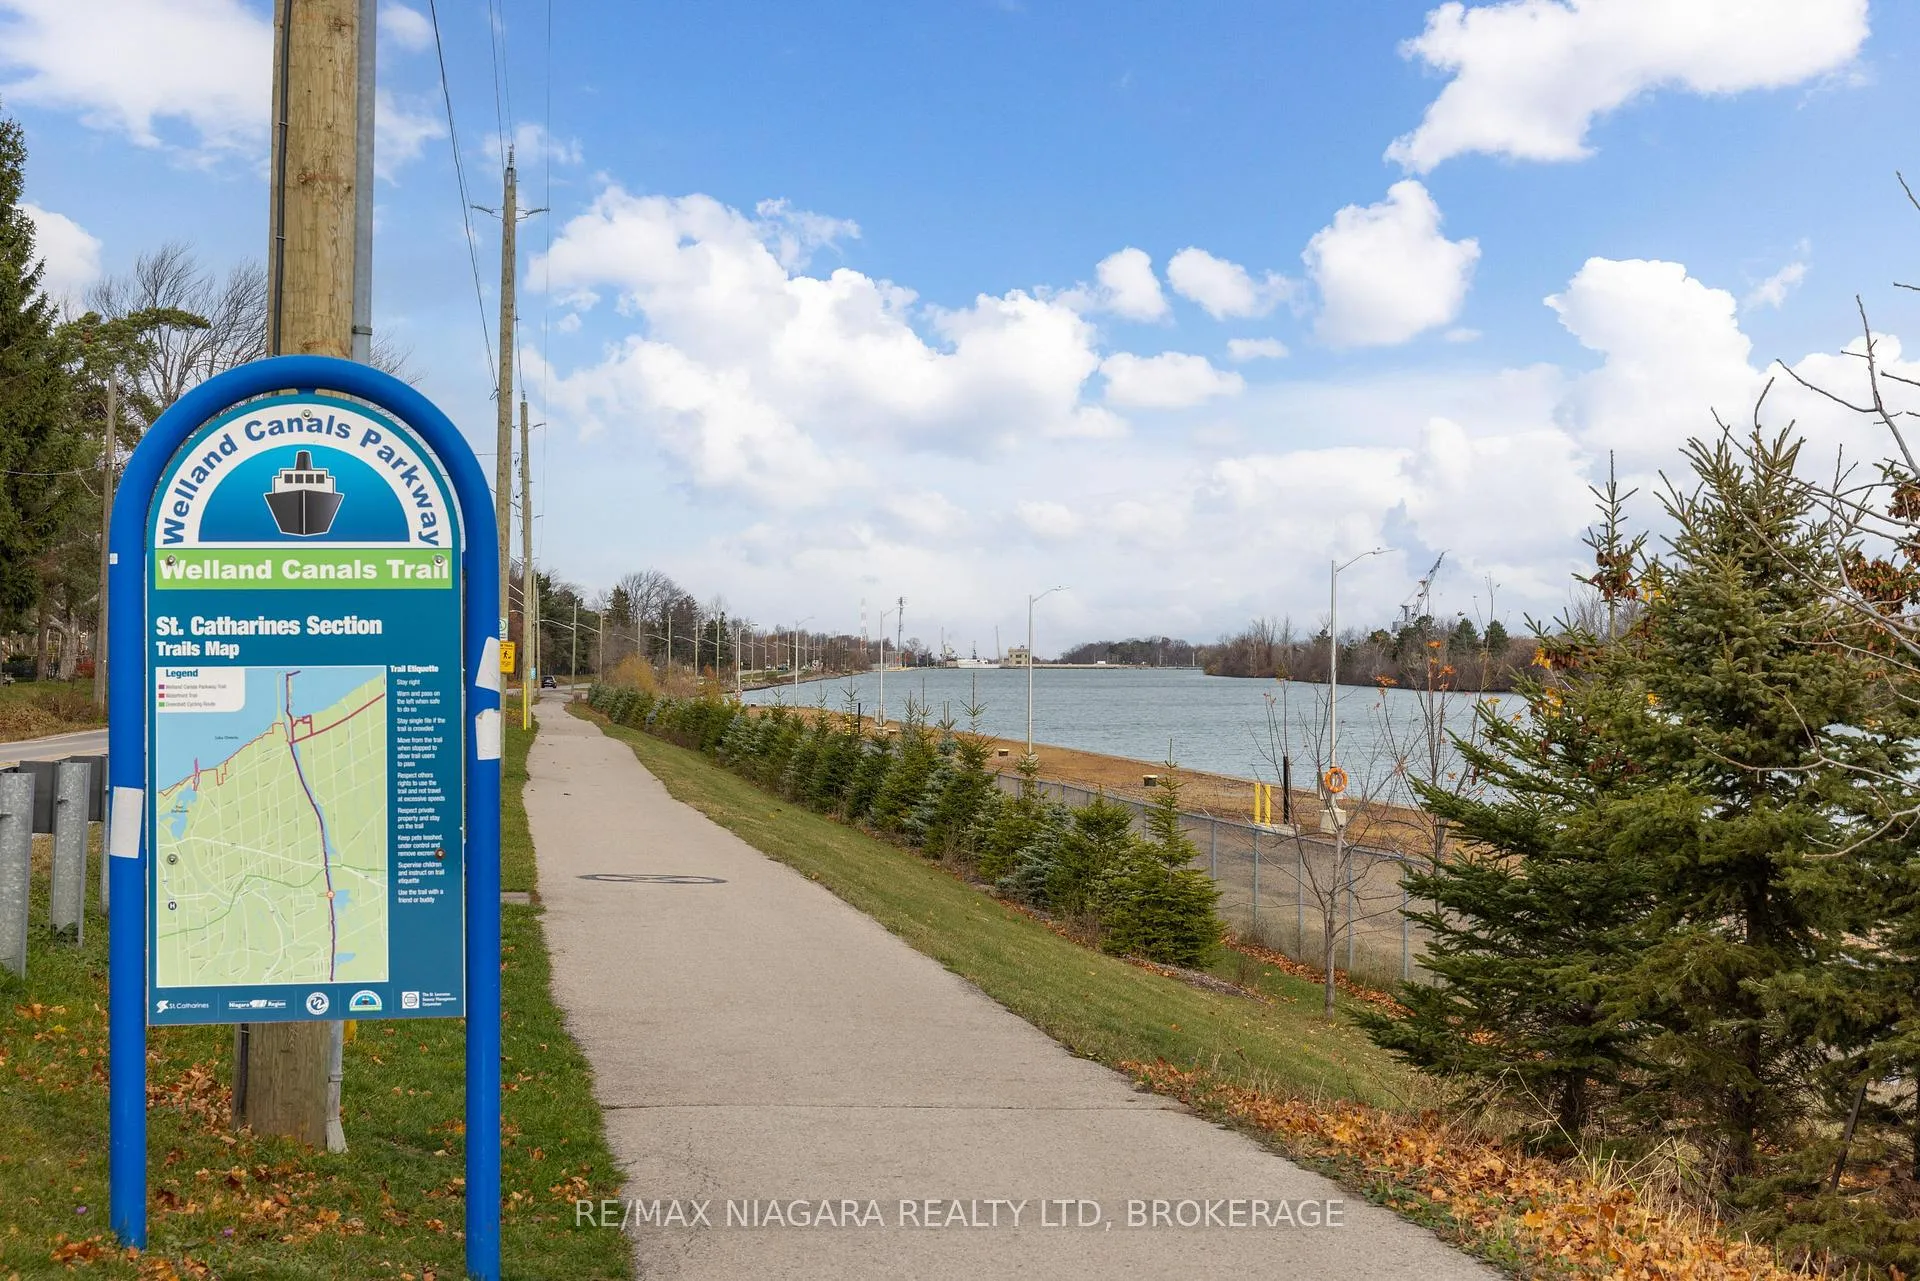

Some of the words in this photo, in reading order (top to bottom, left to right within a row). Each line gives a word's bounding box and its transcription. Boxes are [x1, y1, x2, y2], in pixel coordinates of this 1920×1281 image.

[163, 434, 238, 545] Welland
[244, 415, 351, 442] Canals
[359, 427, 439, 547] Parkway
[159, 559, 272, 580] Welland
[282, 559, 377, 580] Canals
[386, 559, 449, 580] Trail
[156, 616, 184, 636] St.
[191, 616, 301, 636] Catharines
[306, 615, 382, 635] Section
[156, 641, 200, 656] Trails
[205, 641, 240, 659] Map
[166, 669, 198, 679] Legend
[407, 665, 439, 673] Etiquette
